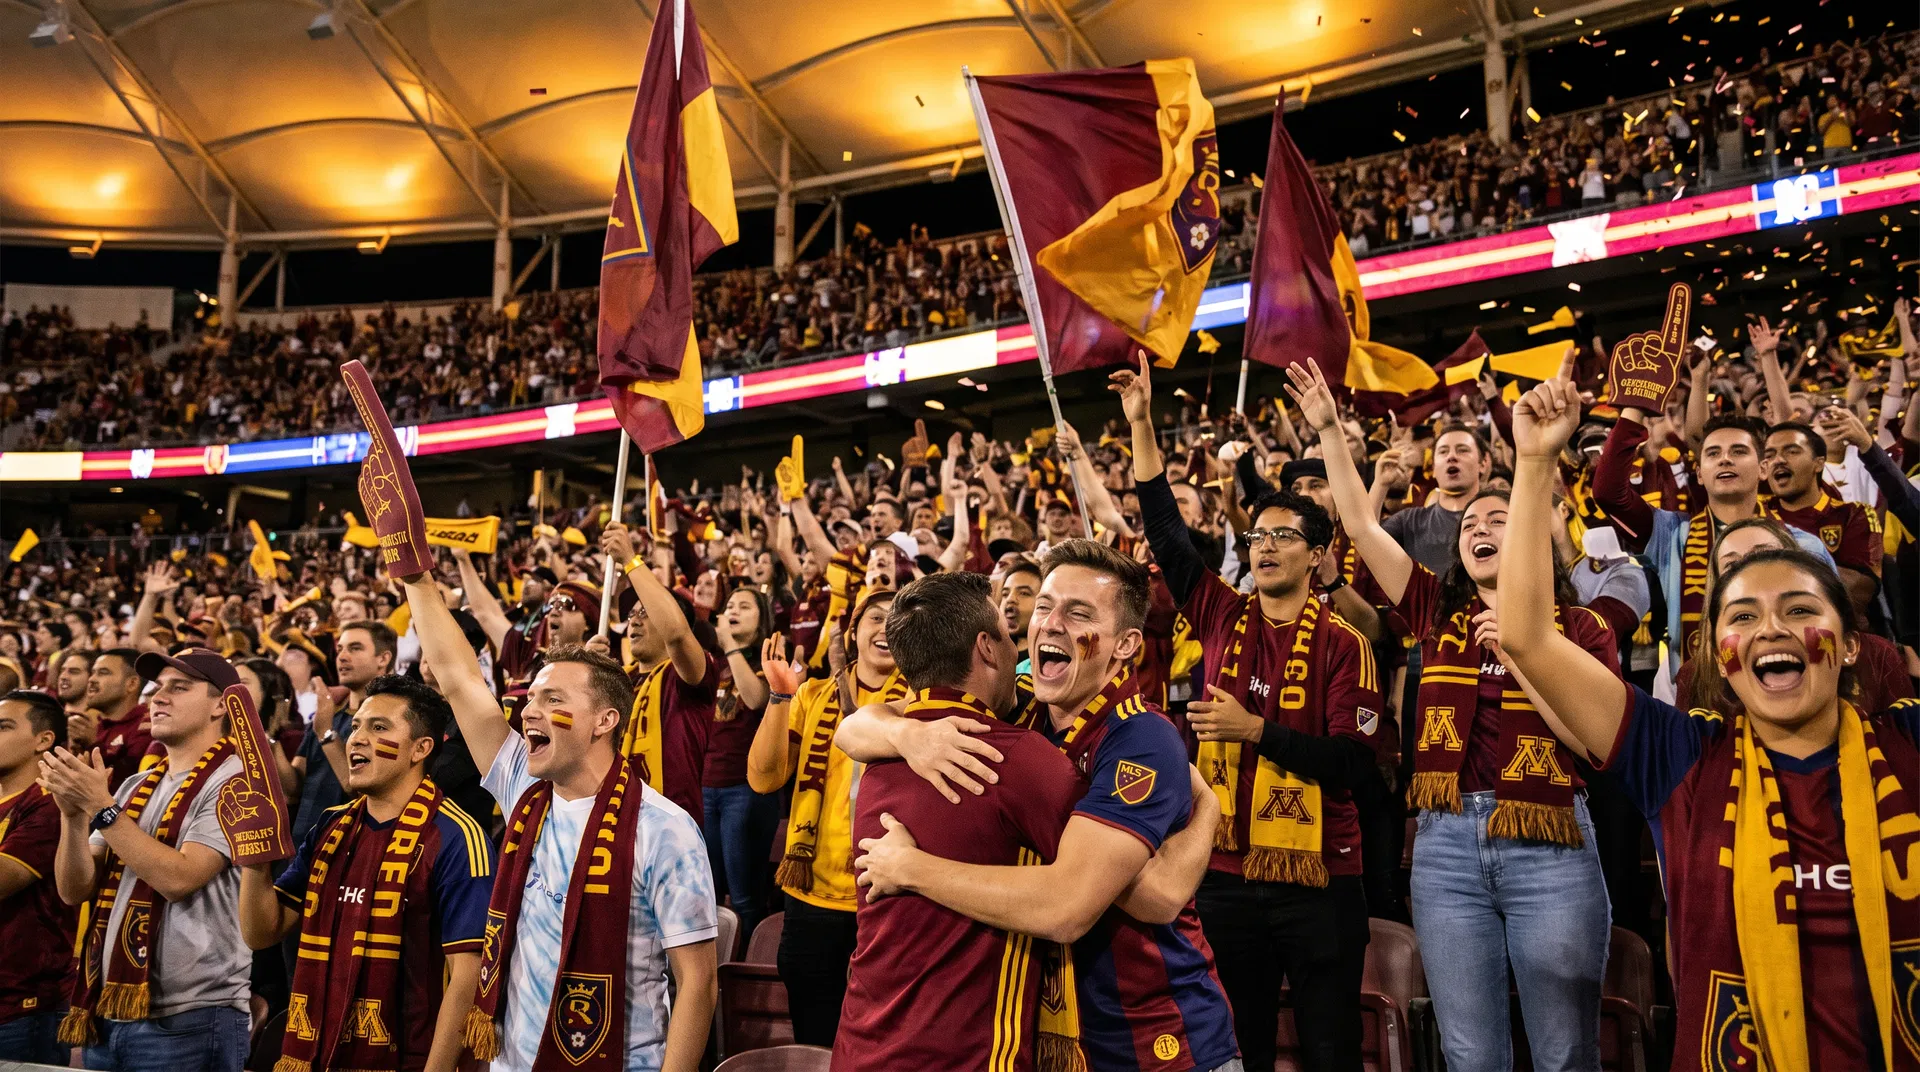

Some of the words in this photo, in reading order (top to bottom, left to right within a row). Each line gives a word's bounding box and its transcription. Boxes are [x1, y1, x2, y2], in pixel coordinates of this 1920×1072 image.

[1418, 706, 1463, 751] M
[1121, 764, 1142, 777] MLS
[1501, 735, 1571, 786] M
[1256, 785, 1314, 825] M
